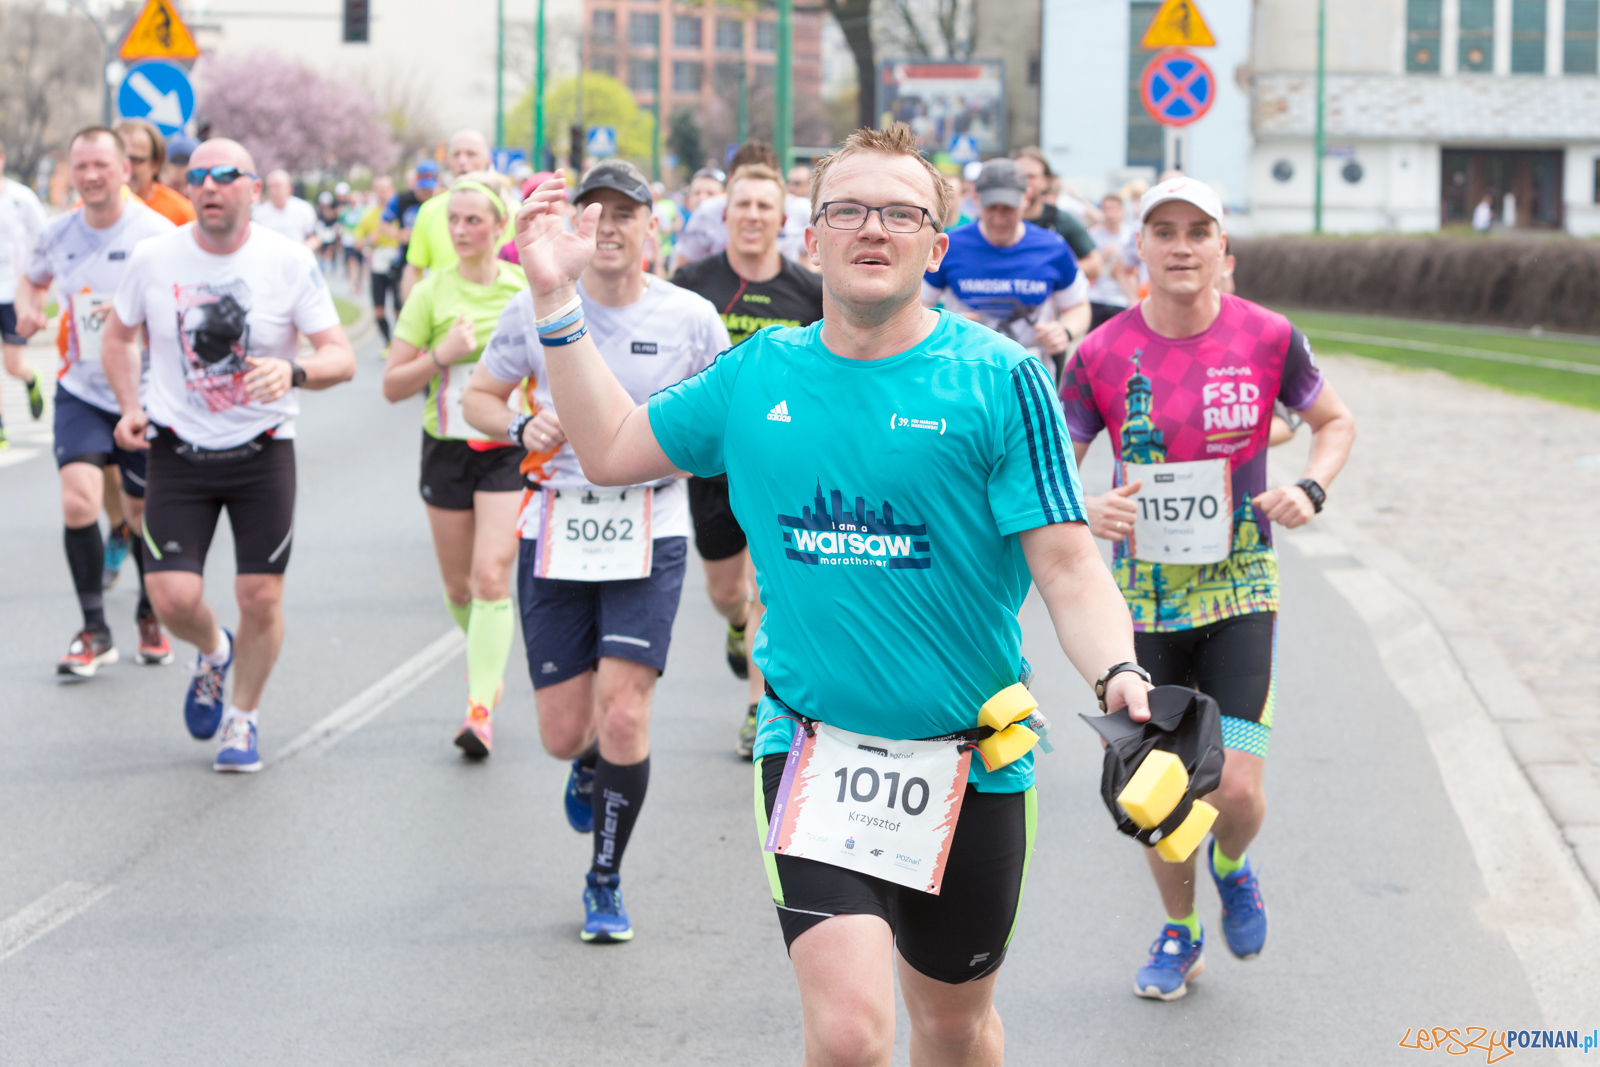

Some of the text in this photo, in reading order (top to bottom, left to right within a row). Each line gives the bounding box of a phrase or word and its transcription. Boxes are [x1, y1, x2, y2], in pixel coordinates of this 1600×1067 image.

[1014, 279, 1048, 296] TEAM
[1203, 382, 1259, 406] FSD
[766, 412, 792, 423] adidas
[898, 417, 910, 427] 39.
[1203, 404, 1259, 431] RUN
[1138, 495, 1218, 521] 11570
[566, 518, 634, 542] 5062
[838, 522, 857, 532] am
[861, 525, 868, 533] a
[792, 528, 912, 557] warsaw
[819, 556, 888, 568] marathoner
[834, 766, 930, 817] 1010
[848, 811, 902, 833] Krzysztof
[869, 848, 885, 857] 4F
